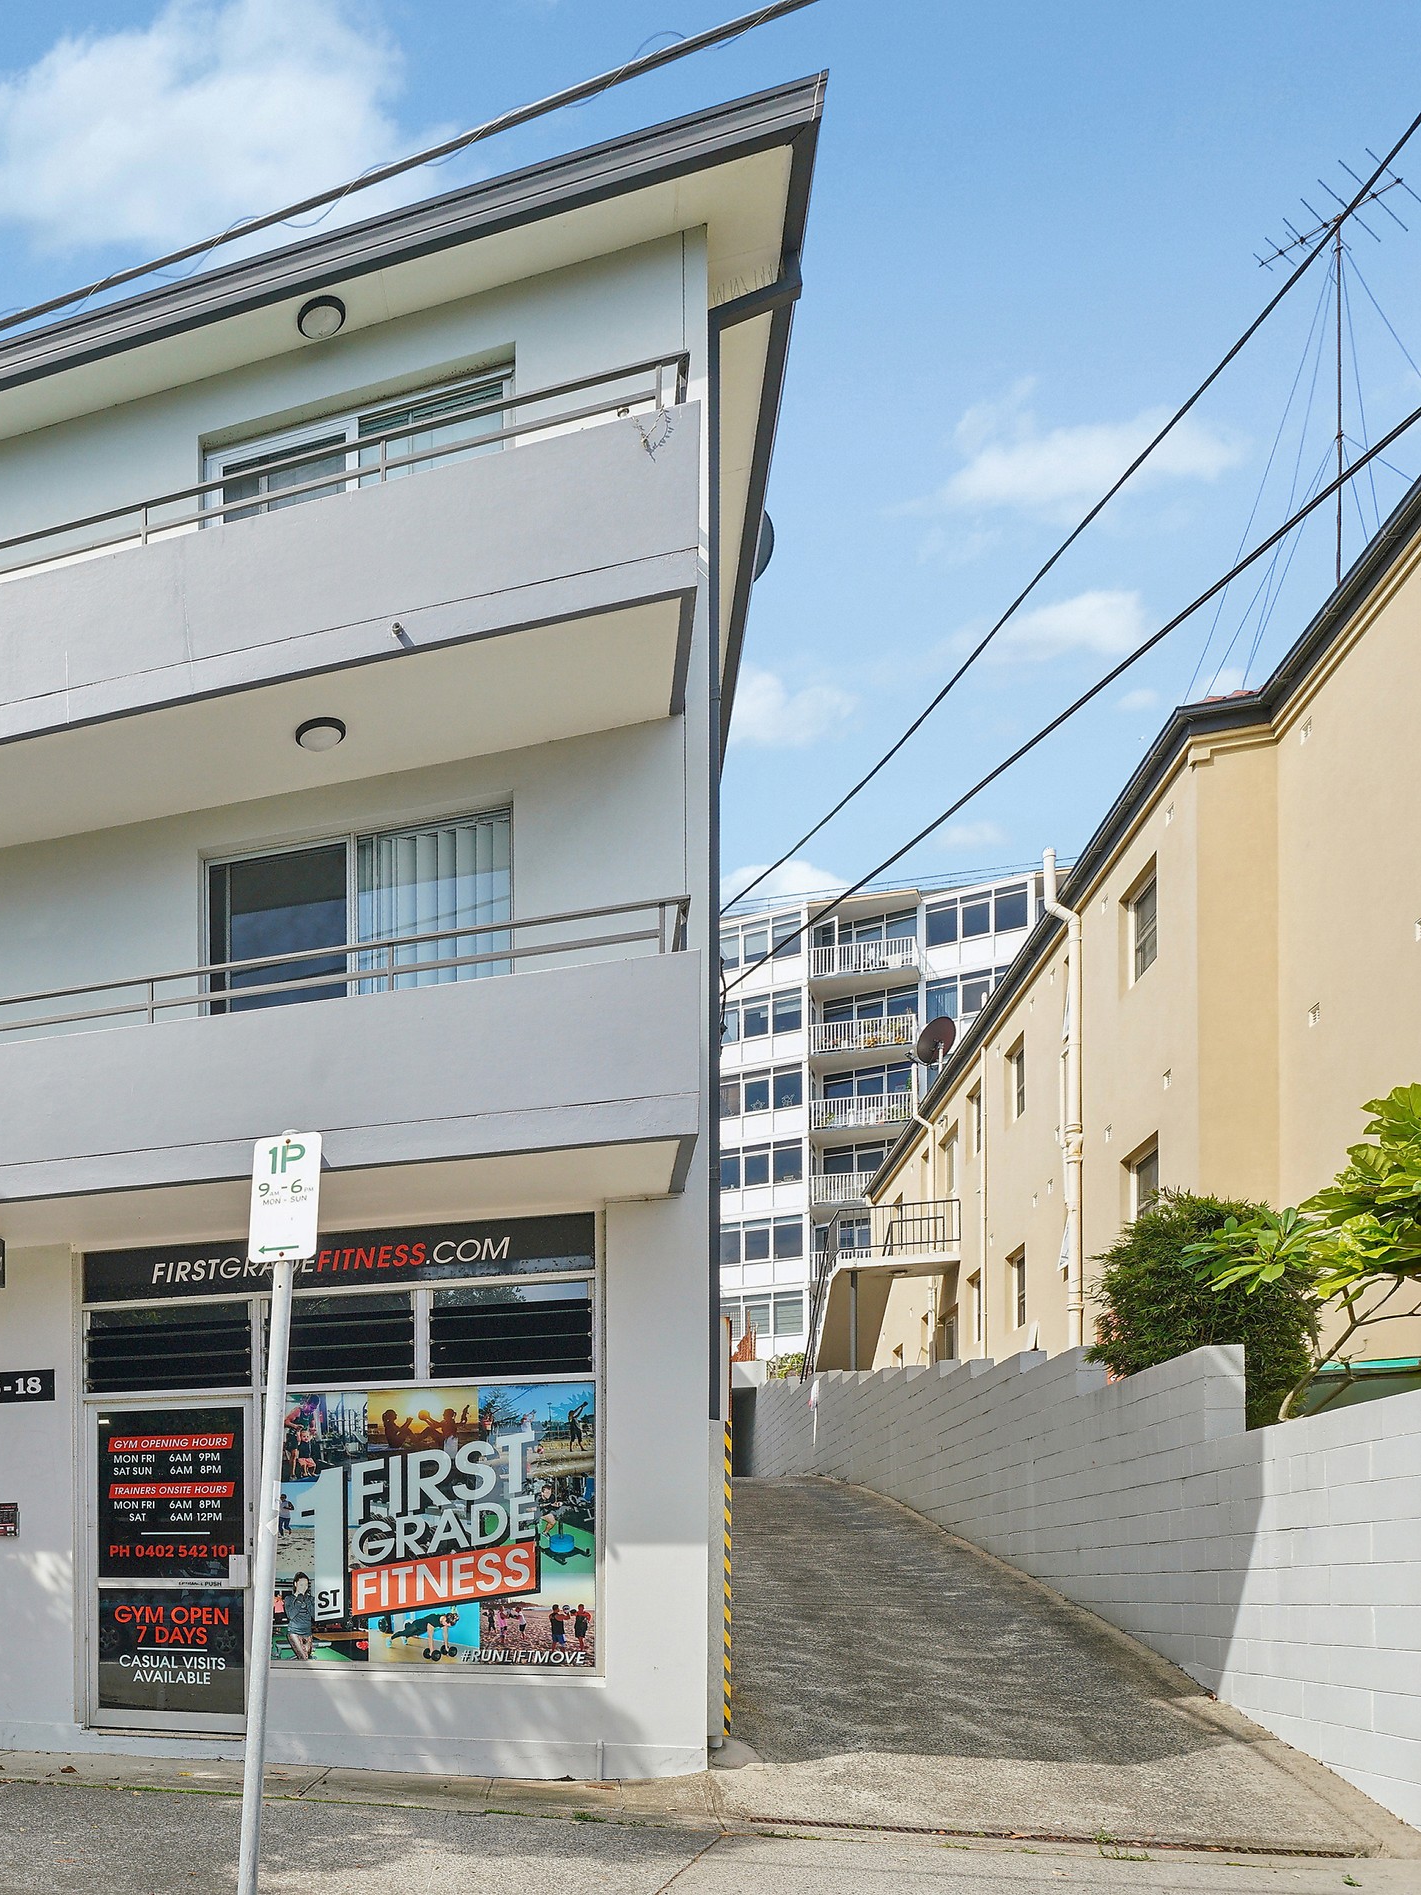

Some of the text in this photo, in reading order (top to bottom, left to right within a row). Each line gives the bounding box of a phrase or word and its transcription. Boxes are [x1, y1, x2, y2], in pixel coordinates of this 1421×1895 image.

[268, 1143, 306, 1175] 1P
[262, 1198, 282, 1206] MON
[290, 1195, 308, 1203] SUN
[113, 1436, 228, 1449] GYM OPENING HOURS
[113, 1452, 221, 1464] MON FRI 6AM 9PM
[113, 1464, 222, 1476] SAT SUN 6AM 8PM
[350, 1430, 536, 1520] FIRST
[114, 1485, 228, 1495] TRAINERS ONSITE HOURS
[113, 1499, 221, 1510] MON FRI 6AM 8PM
[129, 1512, 223, 1522] SAT 6AM 12PM
[350, 1494, 537, 1565] GRADE
[109, 1545, 236, 1558] PH 0402 542 101
[355, 1547, 531, 1611] FITNESS
[317, 1588, 341, 1608] ST
[114, 1605, 229, 1625] GYM OPEN
[136, 1626, 208, 1645] 7 DAYS
[119, 1654, 226, 1670] CASUAL VISITS
[460, 1648, 587, 1665] #RUNLIFTMOVE
[133, 1670, 211, 1685] AVAILABLE
